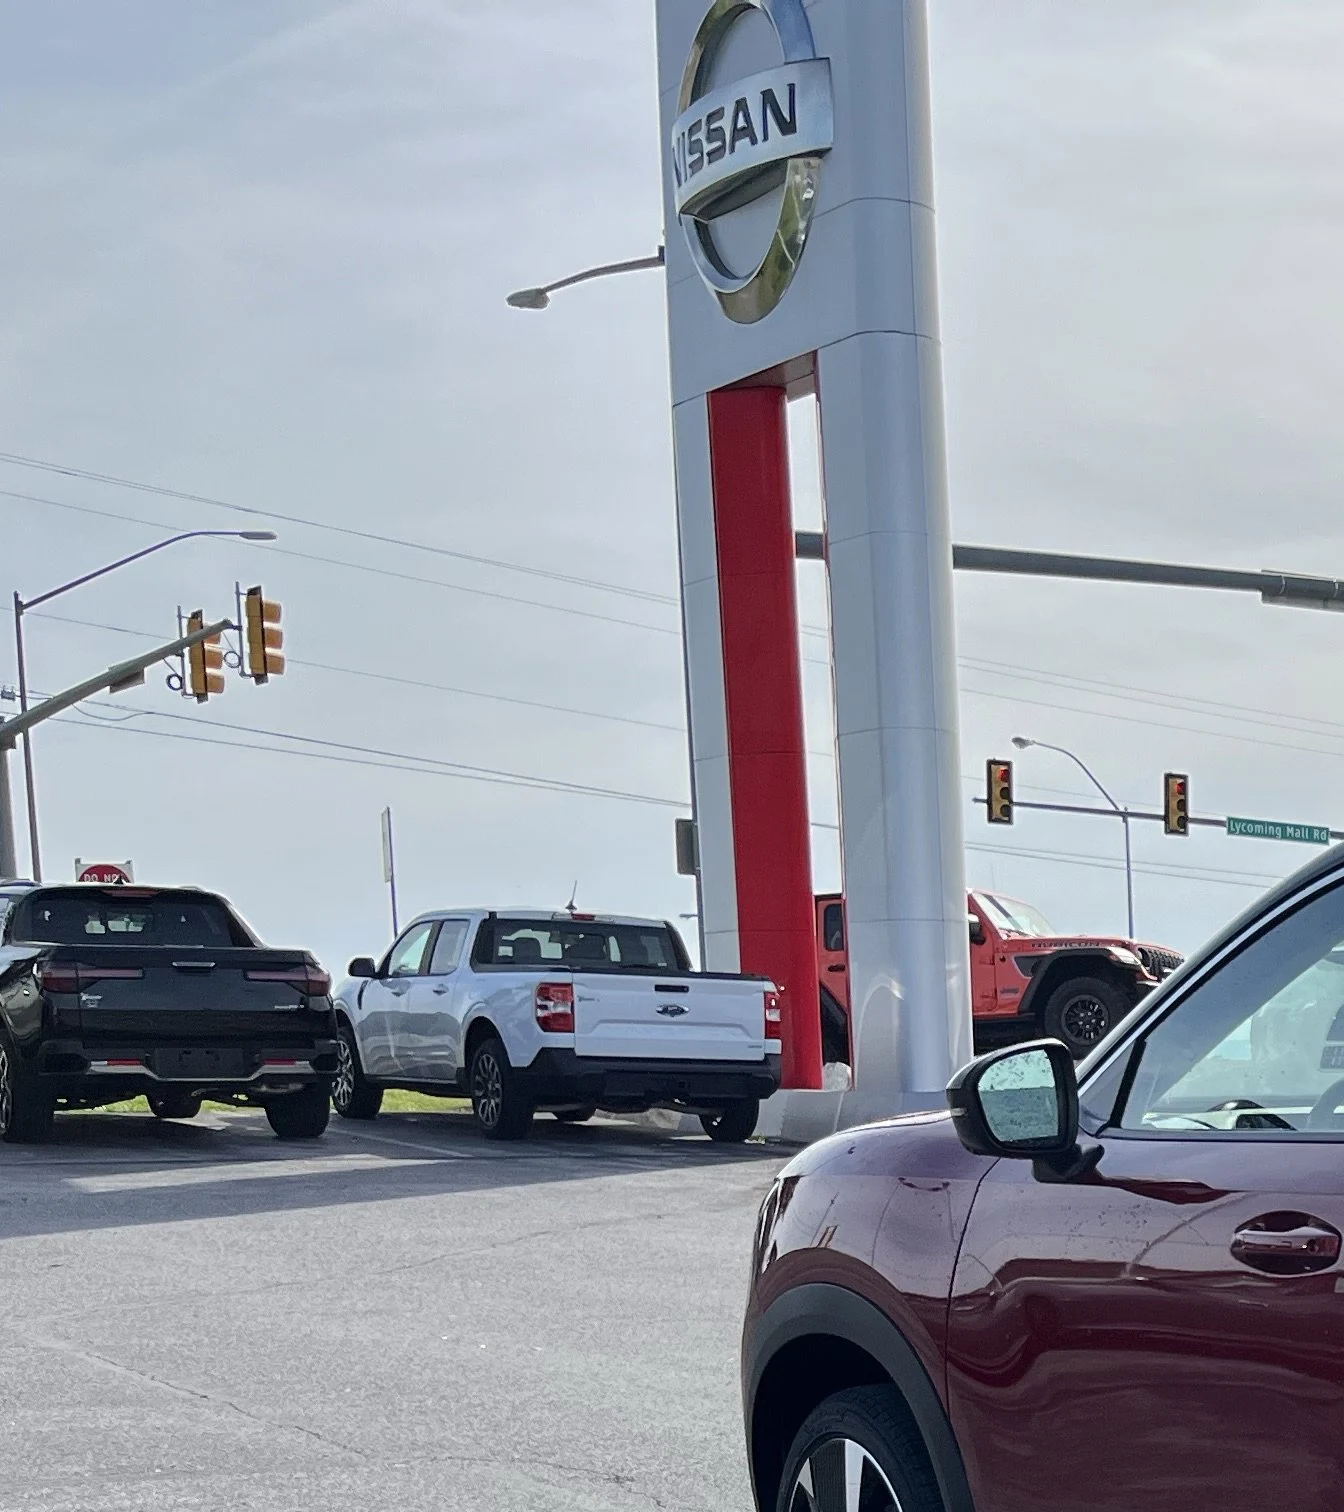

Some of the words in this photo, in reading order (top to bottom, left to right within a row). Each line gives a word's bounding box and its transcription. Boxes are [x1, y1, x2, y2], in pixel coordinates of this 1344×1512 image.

[672, 82, 799, 189] NISSAN
[1230, 820, 1282, 839] Lycoming
[1286, 825, 1309, 839] Mall
[1313, 829, 1327, 841] Rd
[83, 873, 99, 882] DO
[103, 873, 123, 883] NO
